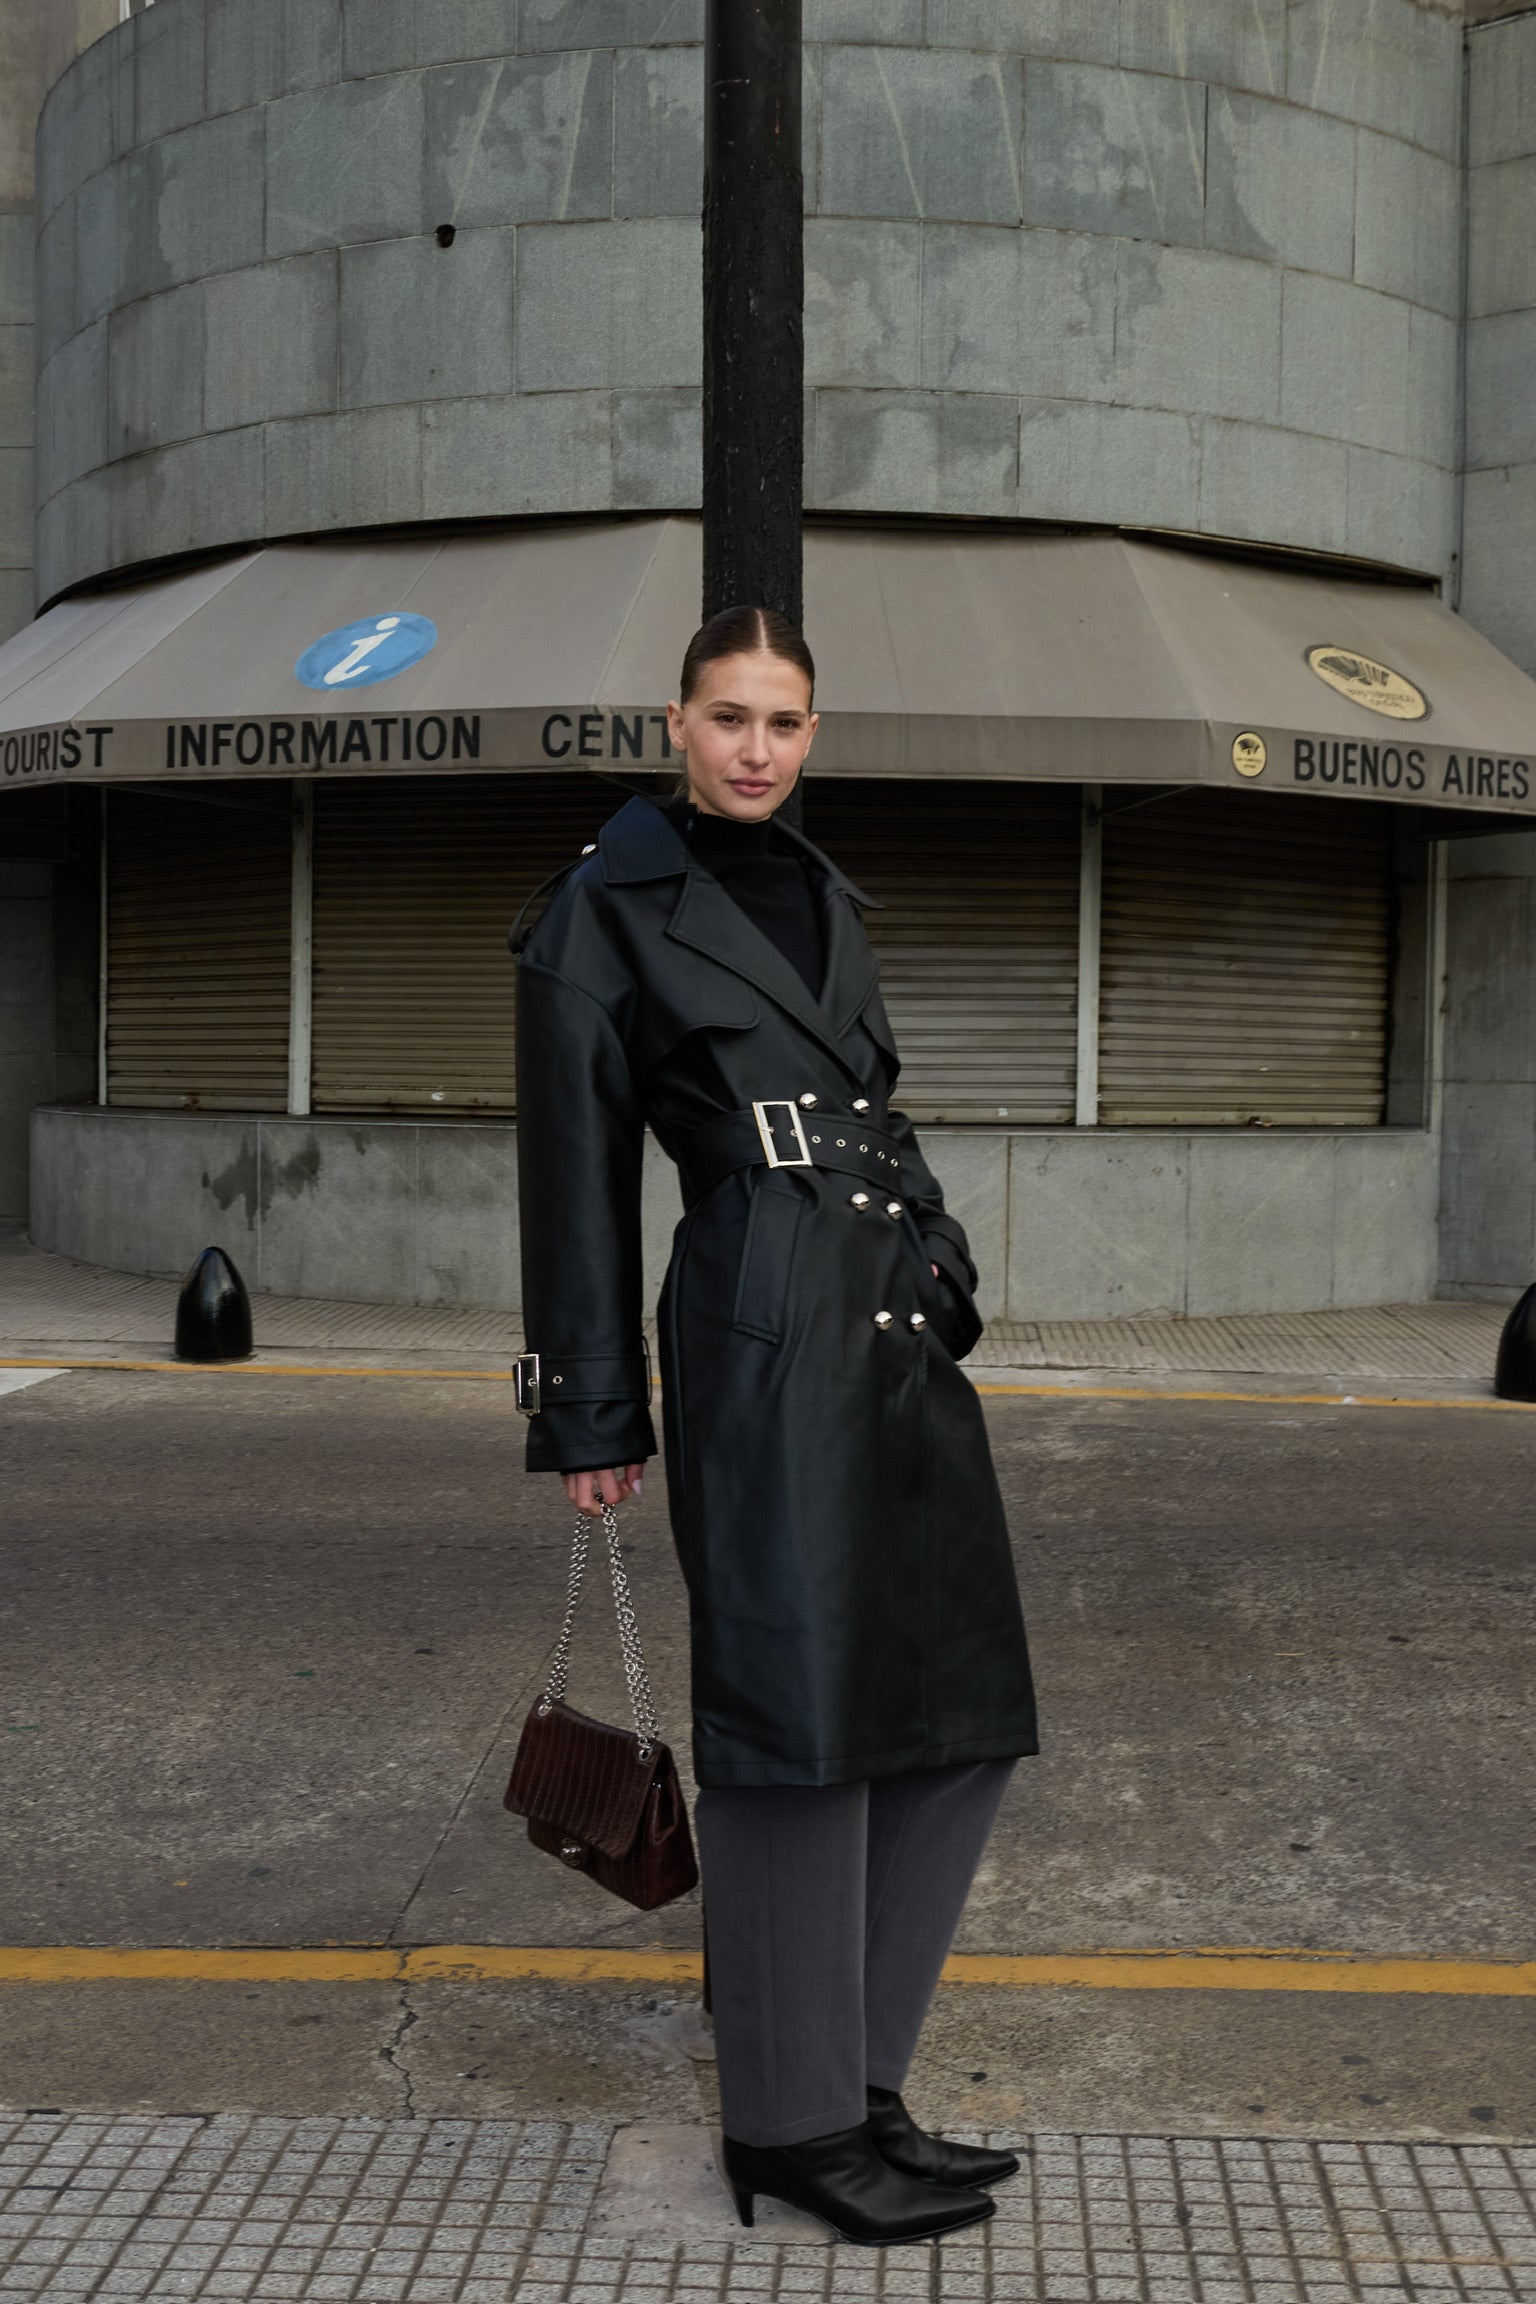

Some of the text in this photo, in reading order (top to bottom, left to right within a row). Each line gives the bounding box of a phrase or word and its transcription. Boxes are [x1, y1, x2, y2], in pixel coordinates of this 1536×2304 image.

[166, 715, 481, 769] INFORMATION
[1294, 738, 1530, 800] BUENOS AIRES
